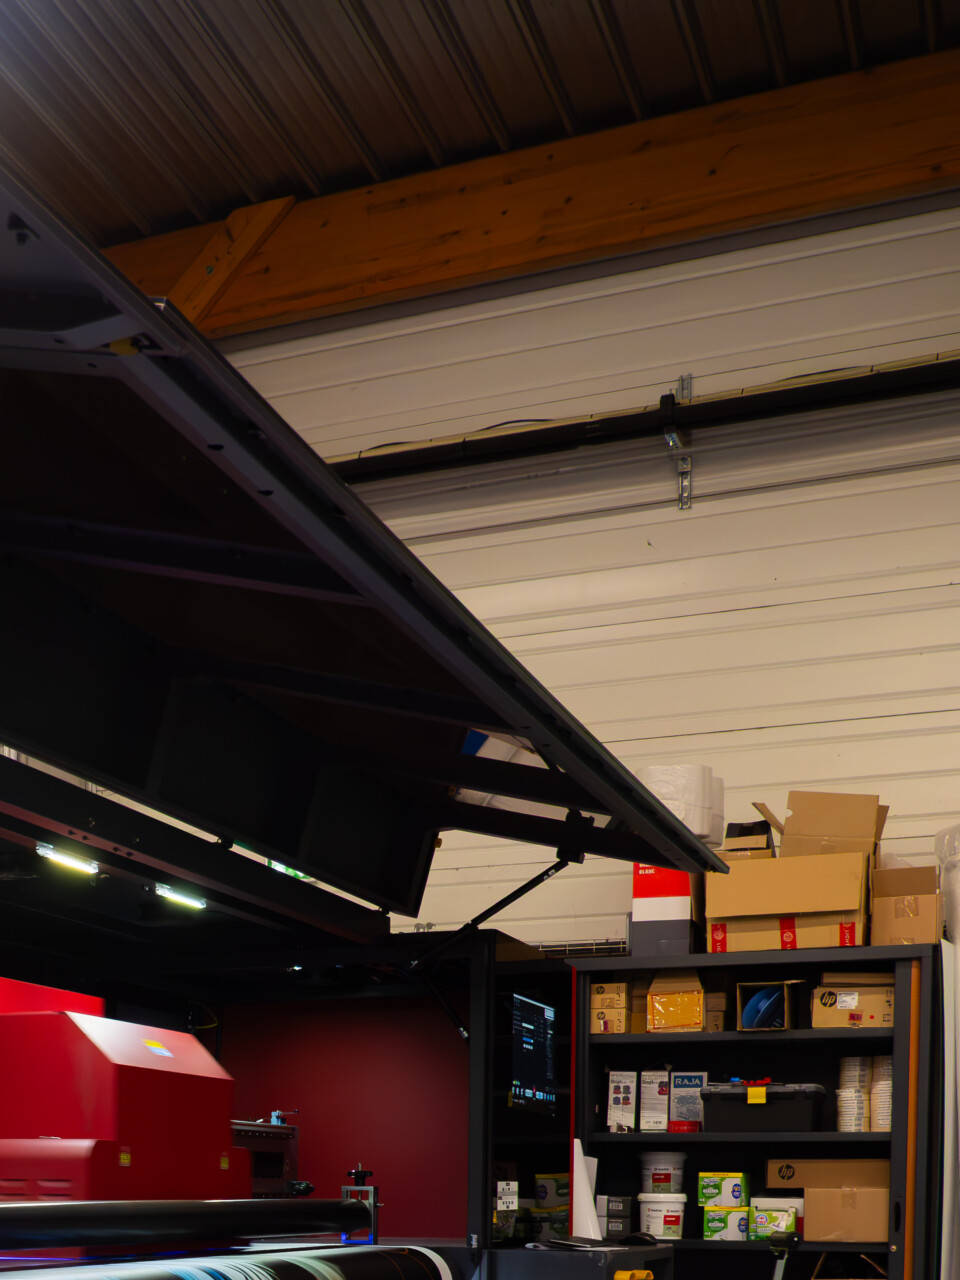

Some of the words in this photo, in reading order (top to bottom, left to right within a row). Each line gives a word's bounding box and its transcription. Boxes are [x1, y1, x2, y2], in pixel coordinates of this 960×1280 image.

[821, 991, 837, 1007] hp
[675, 1077, 701, 1086] RAJA
[779, 1164, 795, 1180] hp
